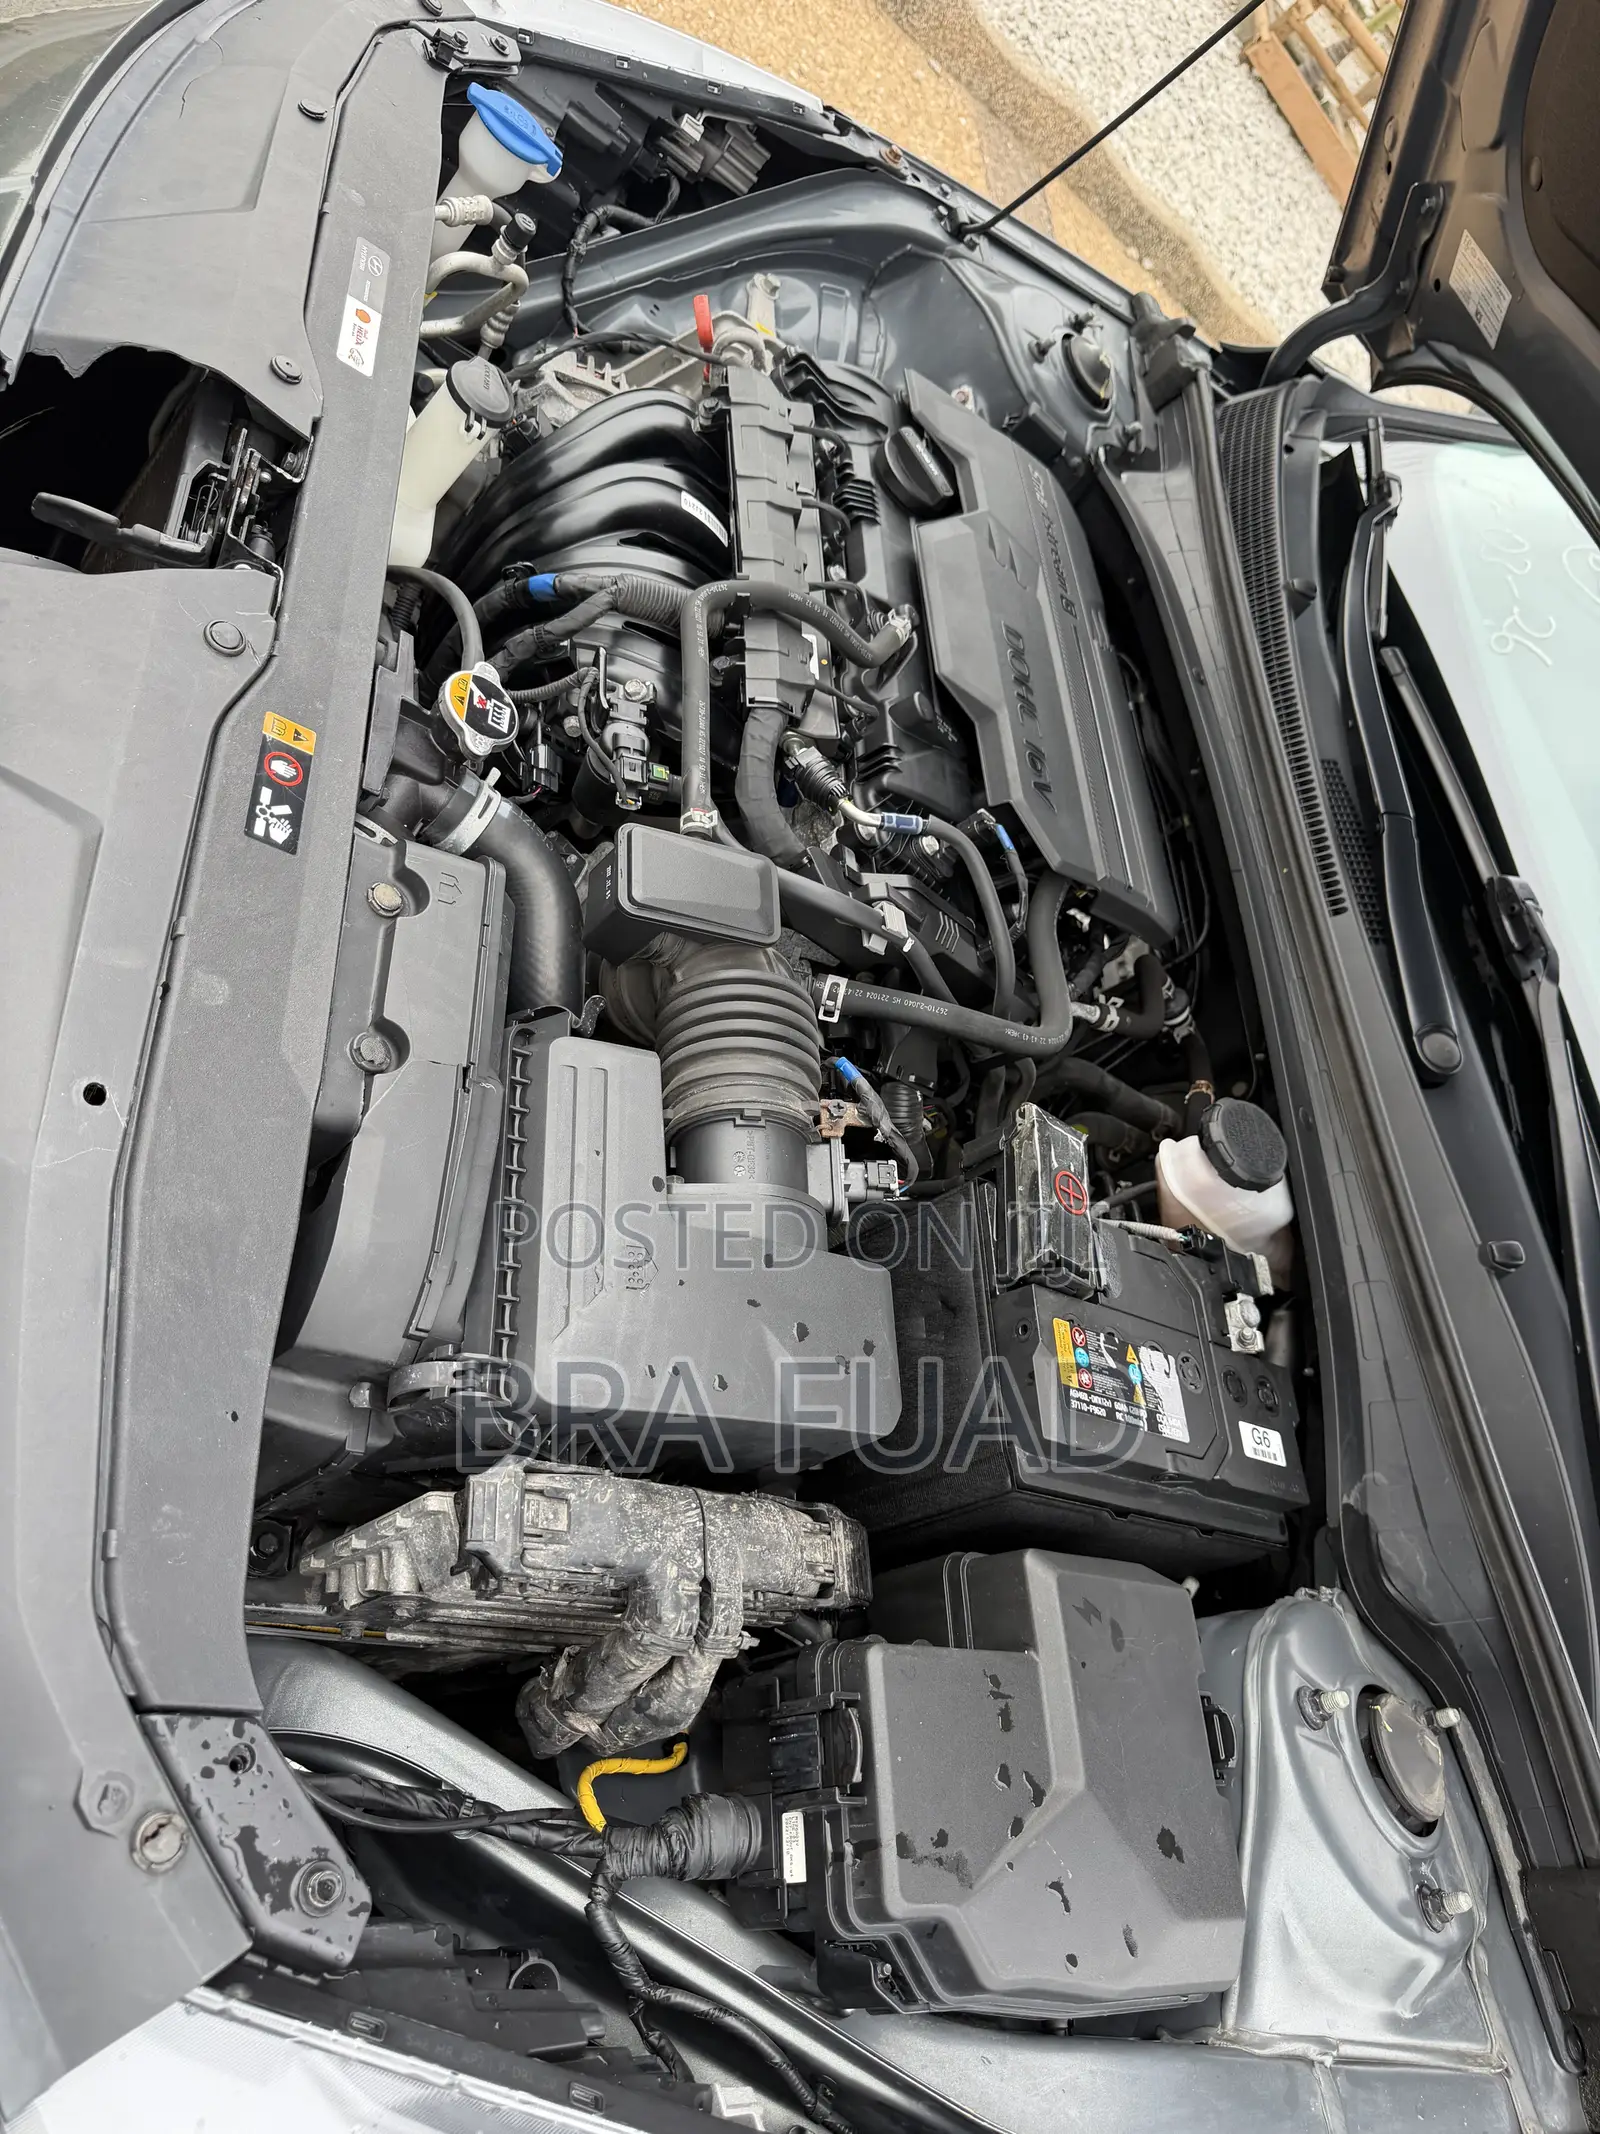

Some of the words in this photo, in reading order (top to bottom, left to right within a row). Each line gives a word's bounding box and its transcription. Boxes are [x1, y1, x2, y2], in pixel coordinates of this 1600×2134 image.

[1001, 620, 1043, 739] DOHC
[1022, 738, 1057, 812] 16V
[866, 991, 890, 1002] 221024
[904, 999, 948, 1016] 26710-2J040
[1252, 1427, 1271, 1449] G6
